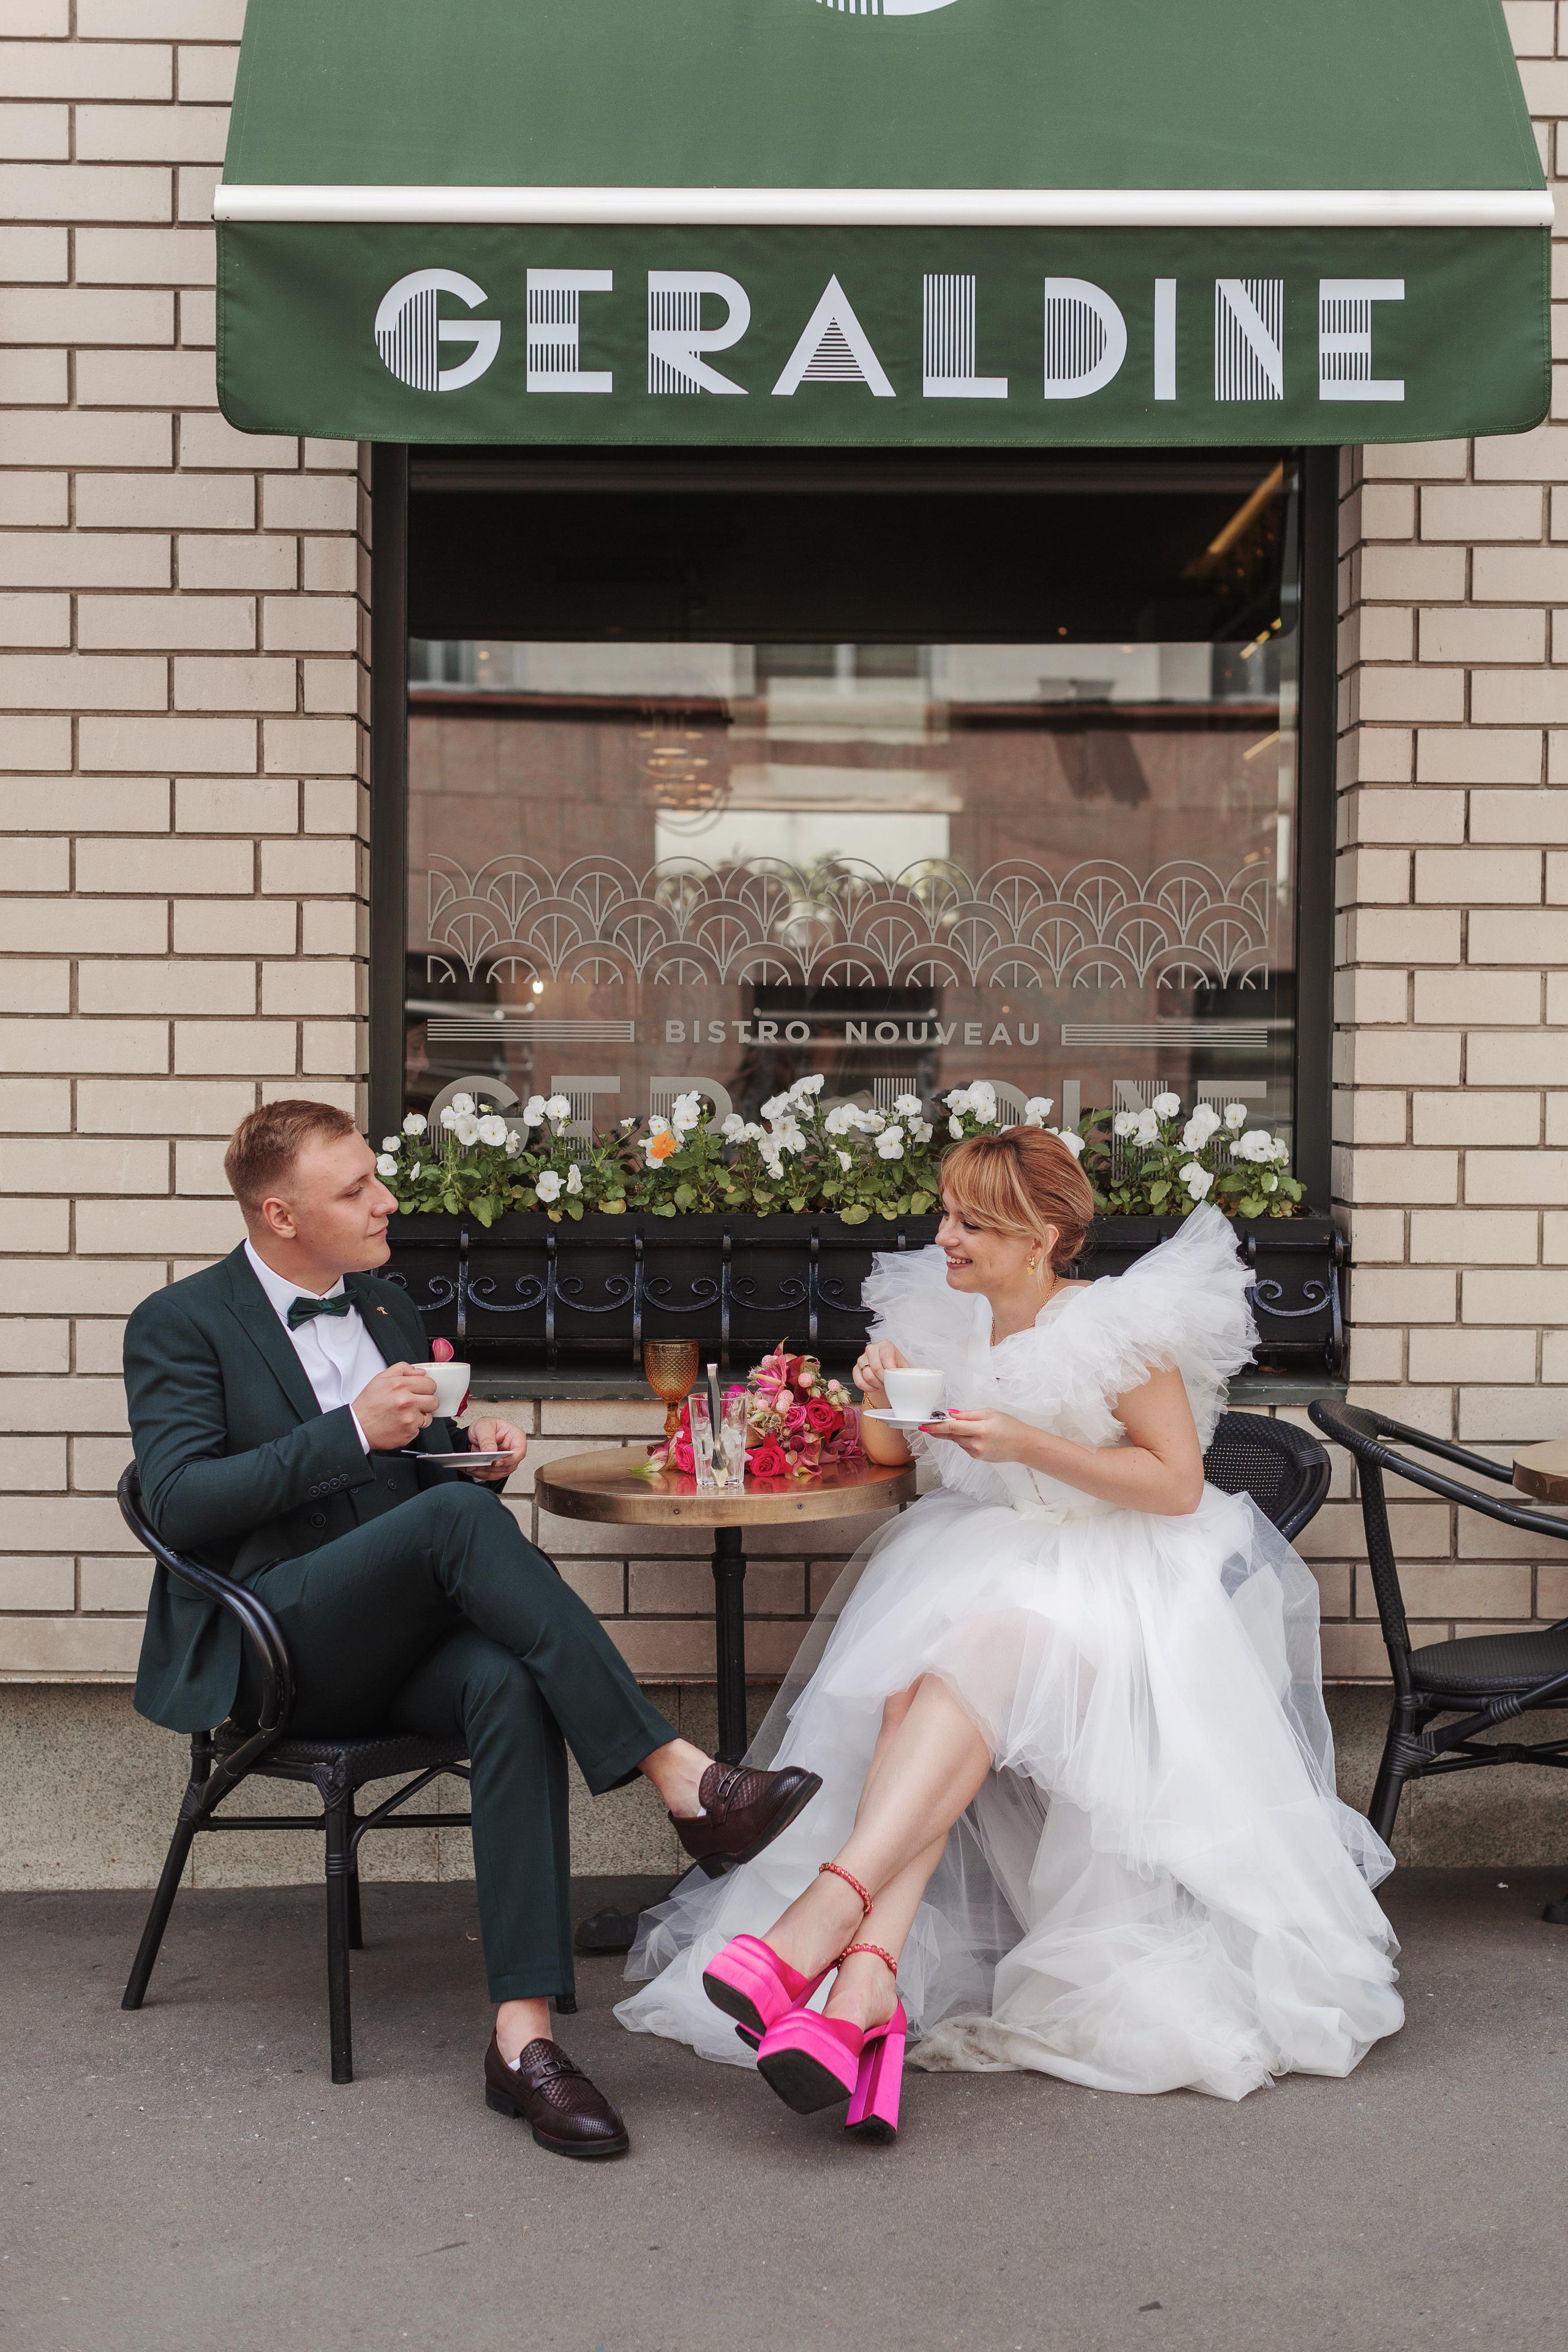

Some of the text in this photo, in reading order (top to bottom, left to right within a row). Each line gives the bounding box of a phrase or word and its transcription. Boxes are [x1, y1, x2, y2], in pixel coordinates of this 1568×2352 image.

[374, 268, 1405, 402] GERALDINE
[665, 1020, 1040, 1046] BISTRO NOUVEAU
